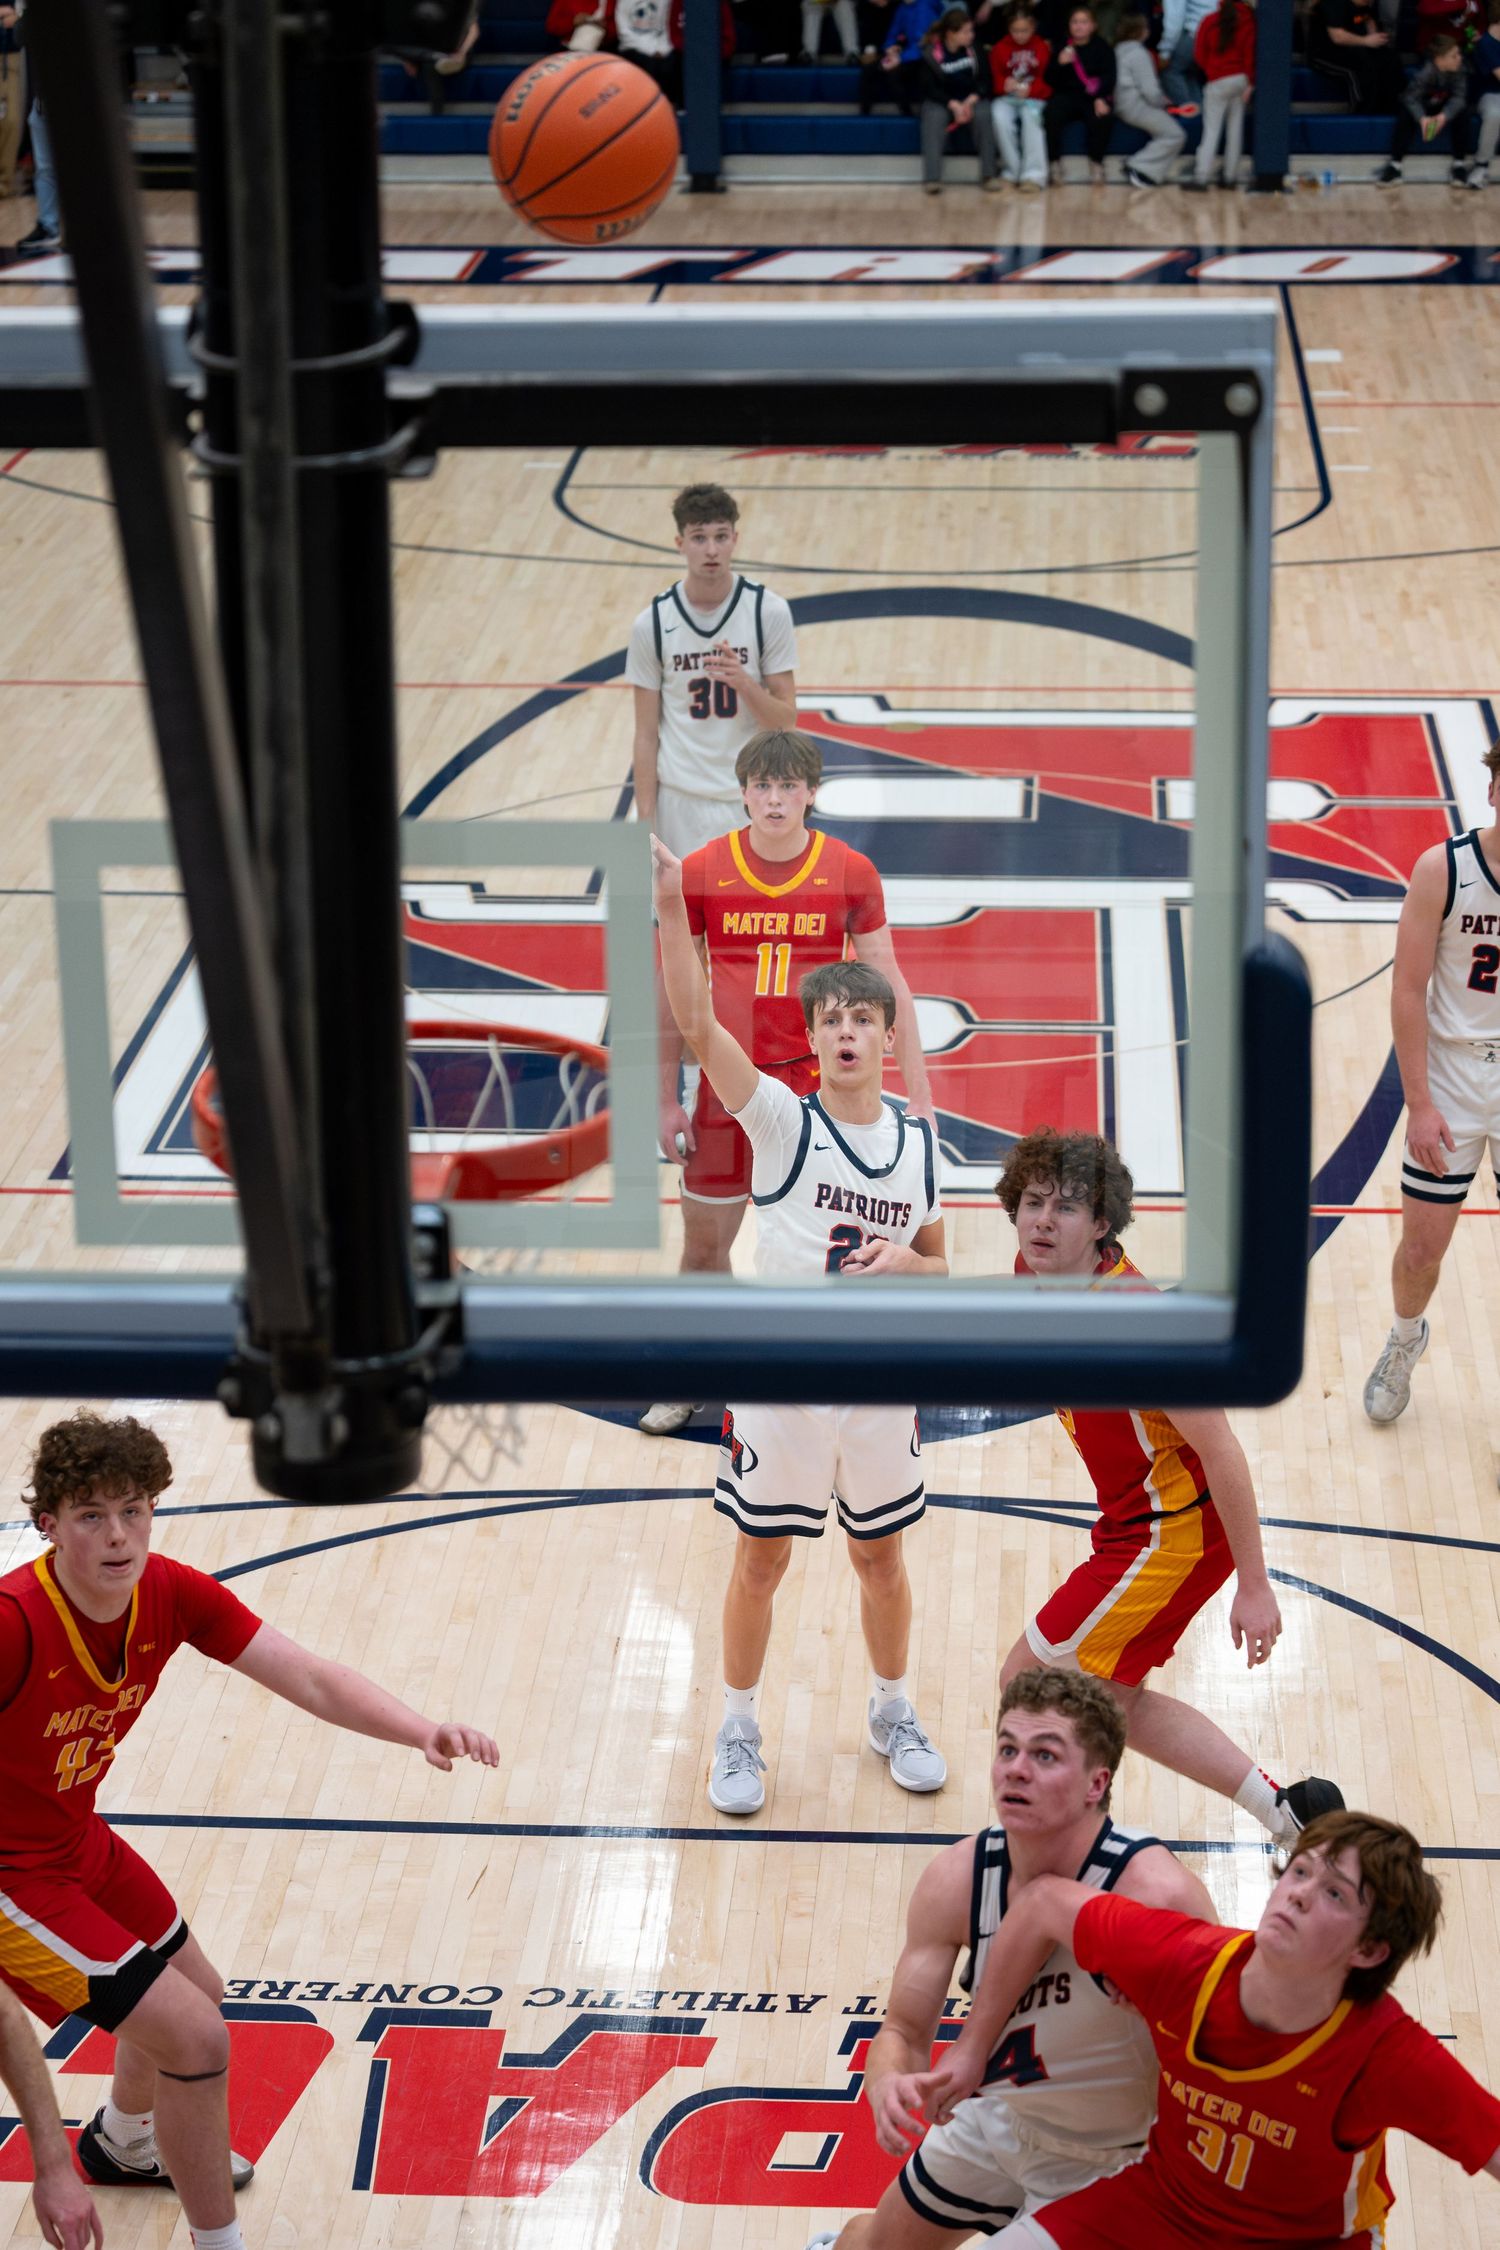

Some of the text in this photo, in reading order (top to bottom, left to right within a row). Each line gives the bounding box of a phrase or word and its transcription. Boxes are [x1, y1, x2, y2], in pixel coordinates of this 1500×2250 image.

[673, 647, 748, 672] PATS
[687, 677, 738, 720] 30
[722, 912, 826, 936] MATER DEI
[1460, 914, 1500, 937] PAT
[755, 942, 792, 996] 11
[814, 1183, 912, 1228] PATRIOTS
[825, 1223, 890, 1273] 2
[224, 1979, 503, 2006] CONFERE
[523, 1987, 828, 2016] ATHLETIC
[970, 2024, 1050, 2098] 4
[1162, 2070, 1297, 2150] ATER DEI
[1187, 2112, 1255, 2192] 31
